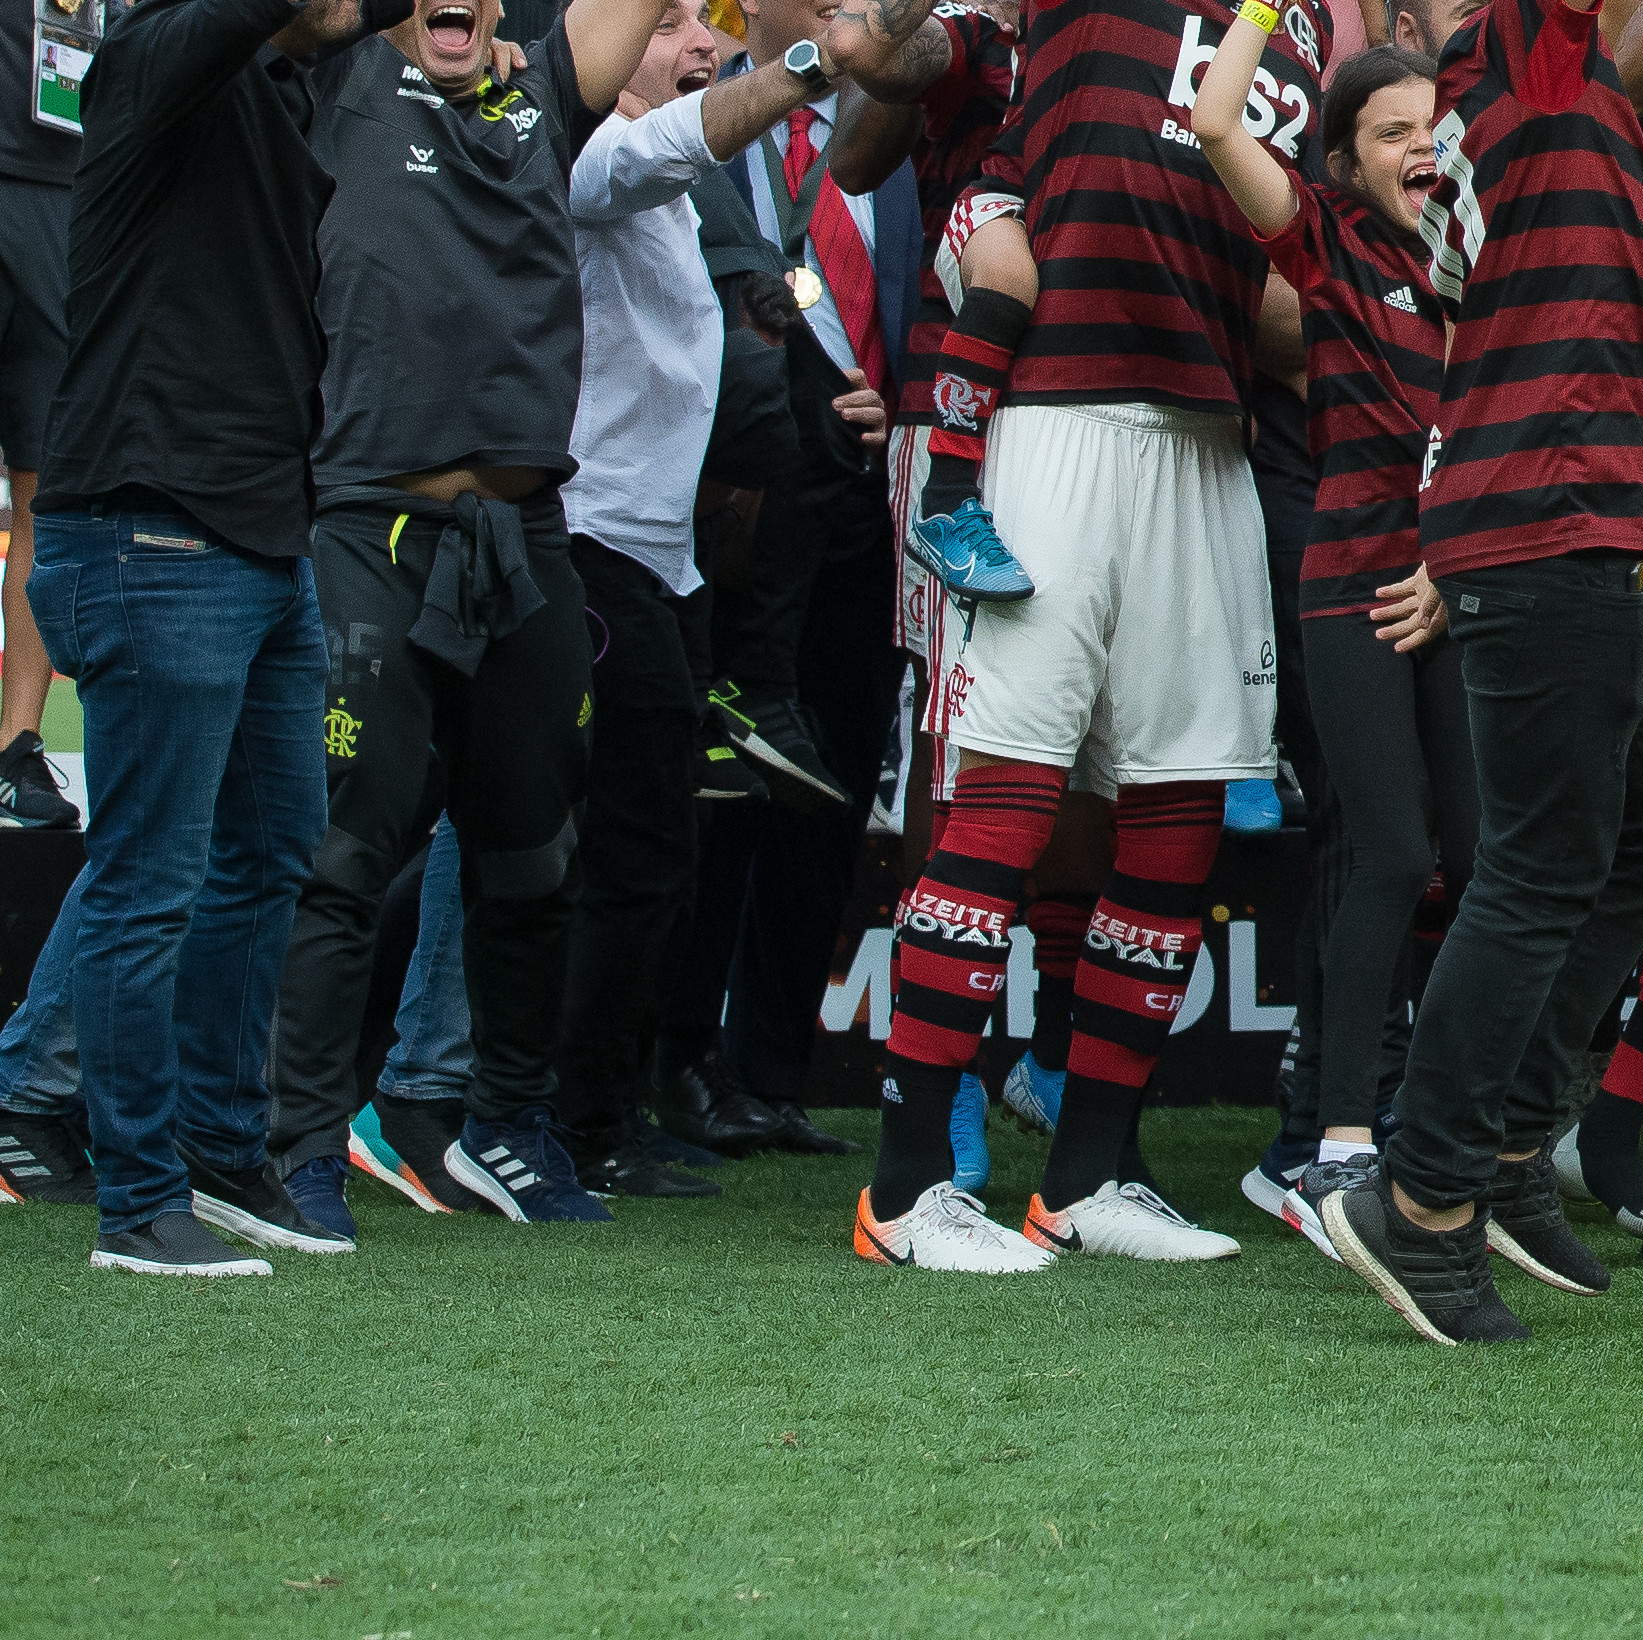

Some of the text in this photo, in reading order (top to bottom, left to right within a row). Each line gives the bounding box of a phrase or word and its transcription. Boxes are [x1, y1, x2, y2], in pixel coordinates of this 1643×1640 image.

[1160, 118, 1202, 150] Ban
[406, 161, 439, 175] buser
[1241, 668, 1277, 688] Bene
[1091, 911, 1186, 951] ZEITE
[1085, 929, 1184, 971] OYAL
[967, 971, 1006, 991] CR
[1144, 991, 1184, 1011] CR
